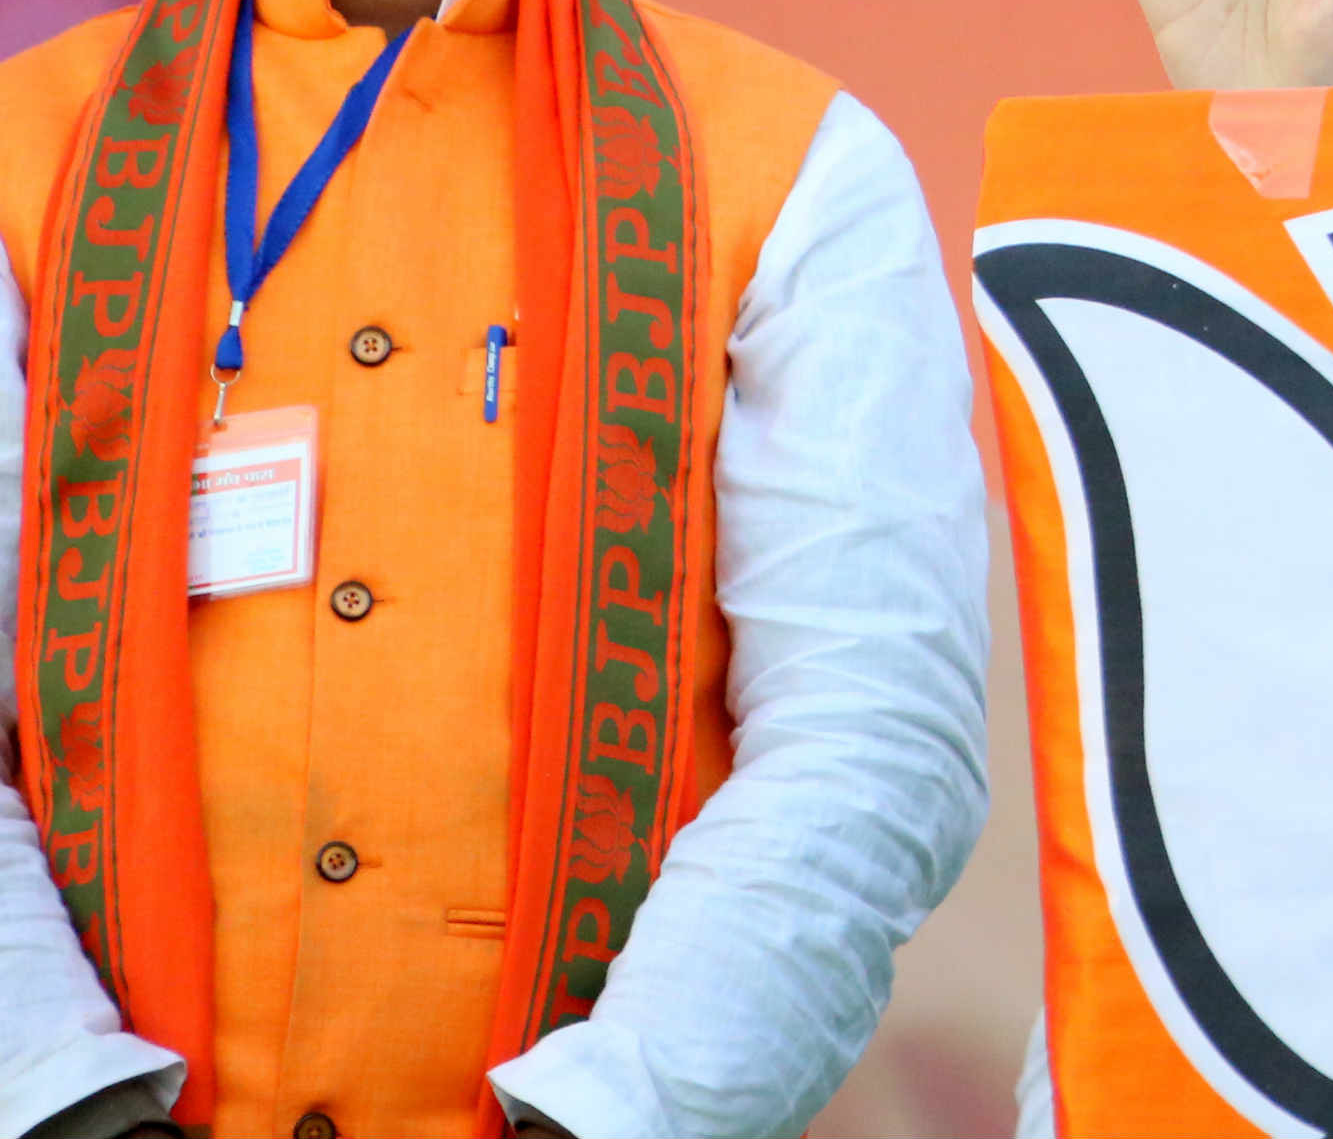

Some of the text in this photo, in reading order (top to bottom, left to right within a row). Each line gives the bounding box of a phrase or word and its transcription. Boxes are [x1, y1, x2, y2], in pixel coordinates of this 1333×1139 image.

[72, 135, 171, 337] BJP
[605, 207, 678, 423] BJP
[45, 471, 124, 692] BJP
[588, 545, 664, 775] BJP
